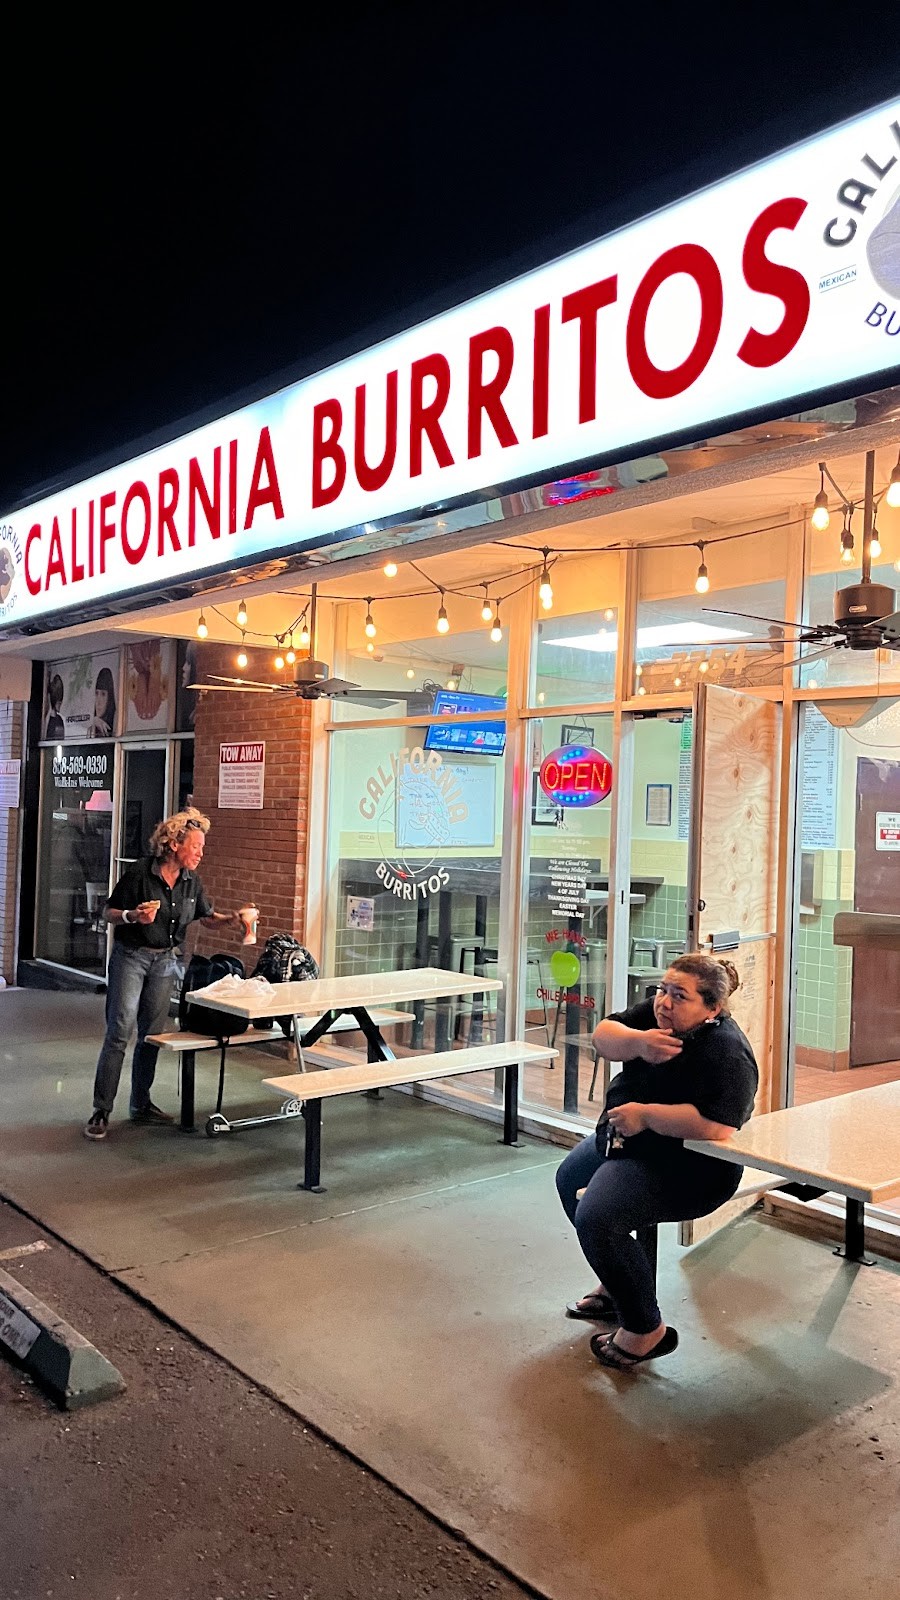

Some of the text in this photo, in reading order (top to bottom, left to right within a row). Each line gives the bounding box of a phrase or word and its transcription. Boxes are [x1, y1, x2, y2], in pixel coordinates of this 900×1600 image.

[818, 269, 857, 290] MEXICAN
[24, 197, 811, 596] CALIFORNIA BURRITOS
[222, 746, 262, 762] TOW AWAY
[54, 776, 104, 788] Walk-Ins Welcome
[359, 747, 470, 824] CALIFORNIA
[544, 762, 608, 791] OPEN
[375, 862, 450, 900] BURRITOS
[551, 909, 575, 917] MEMORIAL
[545, 929, 559, 944] WE
[536, 988, 596, 1009] CHILE APPLES
